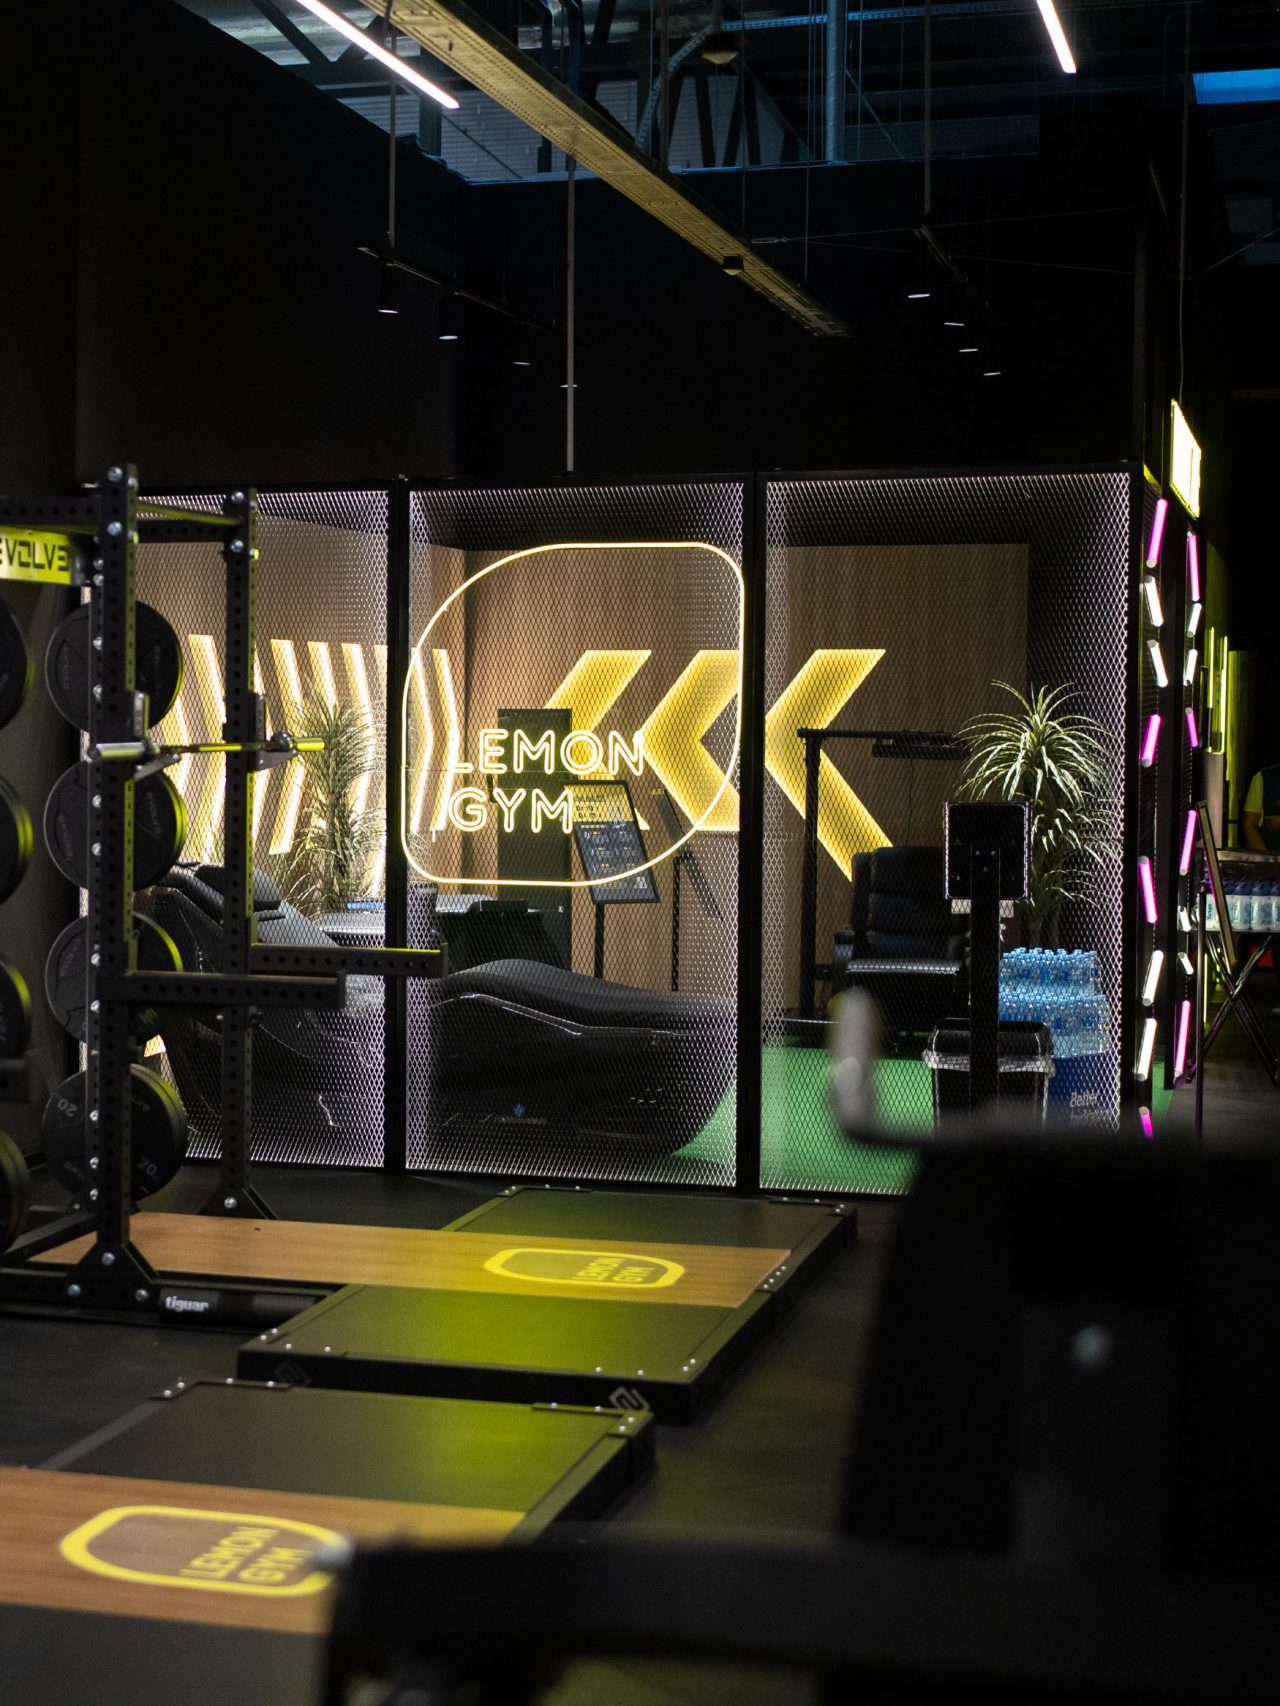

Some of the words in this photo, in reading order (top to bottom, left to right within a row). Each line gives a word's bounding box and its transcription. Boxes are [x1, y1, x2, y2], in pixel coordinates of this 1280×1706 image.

[447, 728, 645, 777] LEMON
[447, 787, 575, 835] GYM
[57, 1097, 78, 1118] 20
[137, 1157, 159, 1178] 20
[165, 1295, 209, 1312] tiguar
[179, 1526, 280, 1579] LEMON
[238, 1546, 314, 1583] GYM
